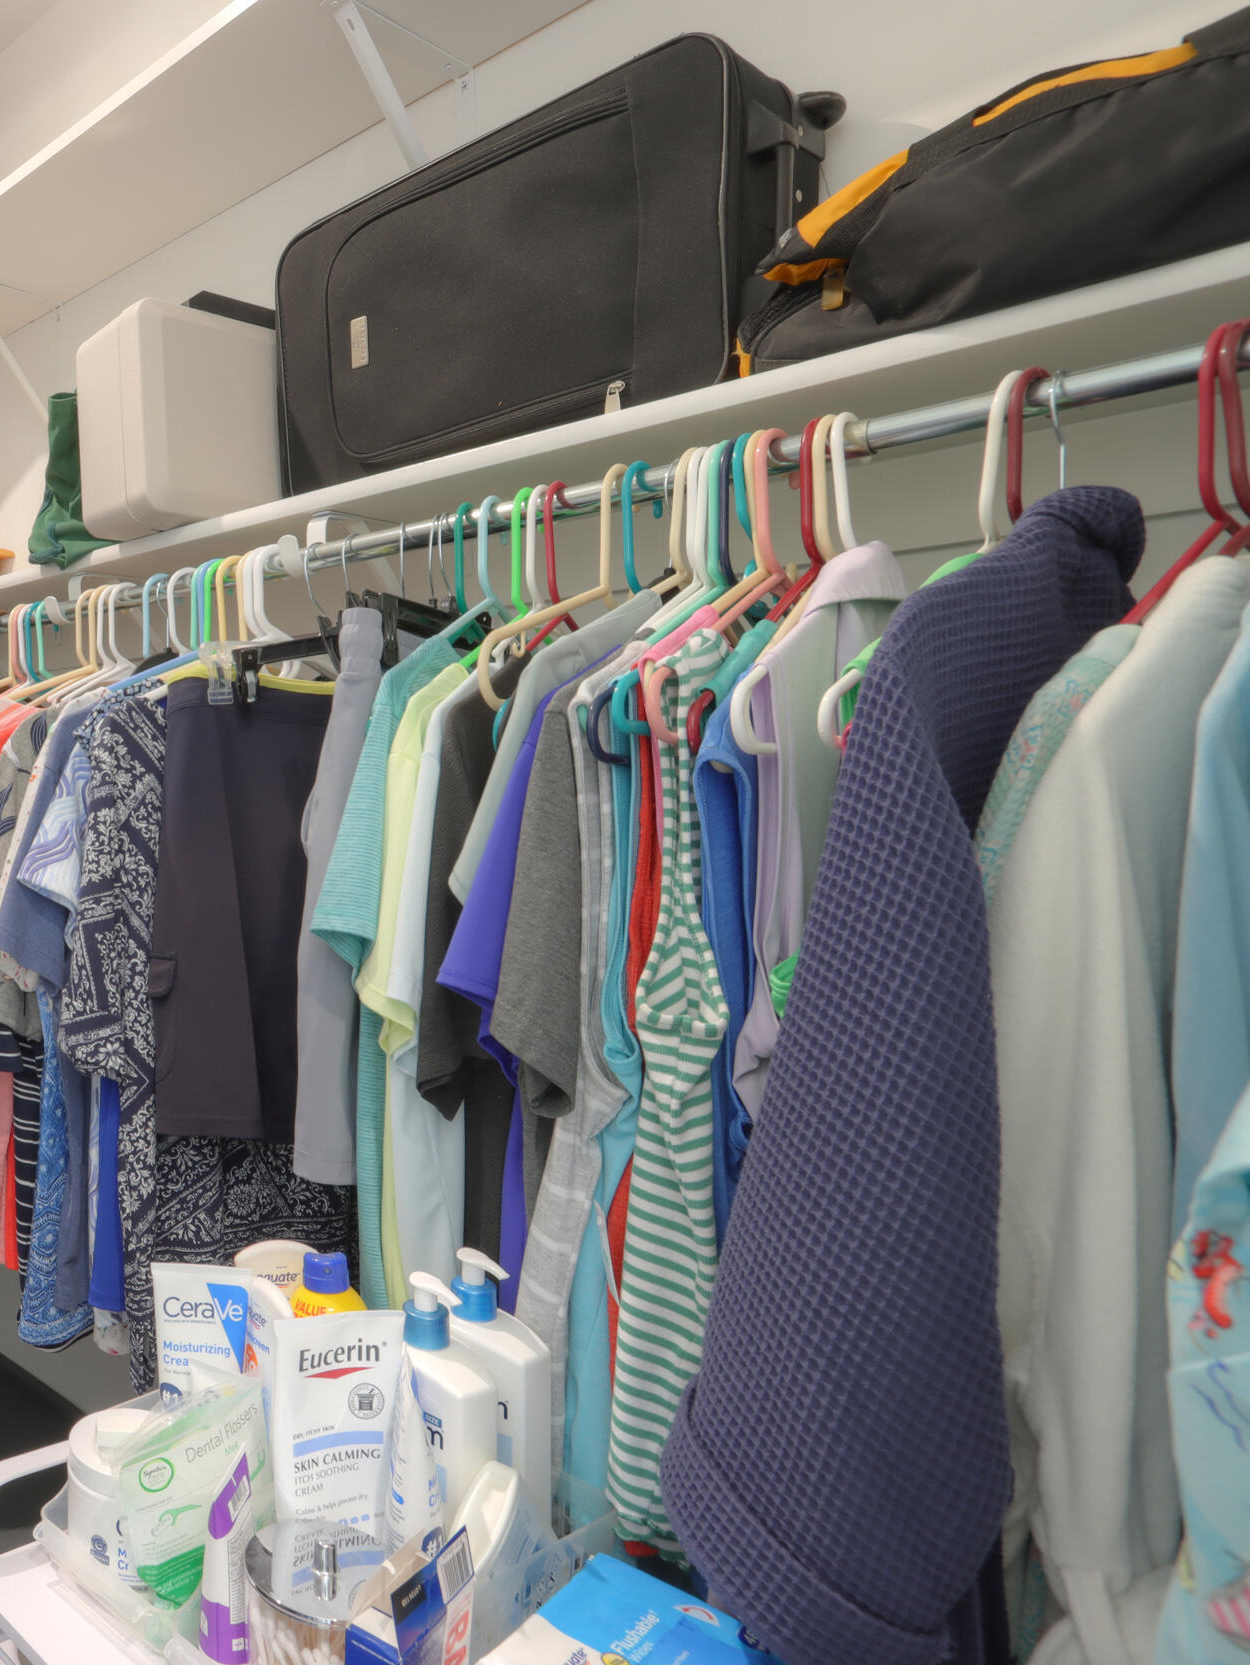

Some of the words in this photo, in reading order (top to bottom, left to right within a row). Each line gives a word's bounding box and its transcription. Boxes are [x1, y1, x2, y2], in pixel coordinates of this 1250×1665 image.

[163, 1296, 244, 1322] CeraVe
[294, 1298, 327, 1317] VALUE
[163, 1341, 231, 1358] Moisturizing
[163, 1354, 189, 1367] Crea
[299, 1338, 380, 1372] Eucerin
[185, 1428, 225, 1463] Dental
[224, 1403, 258, 1437] Flossers
[294, 1457, 319, 1474] SKIN
[323, 1448, 381, 1466] CALMING
[294, 1473, 314, 1486] ITCH
[316, 1462, 359, 1479] SOOTHING
[295, 1483, 324, 1497] CREAM
